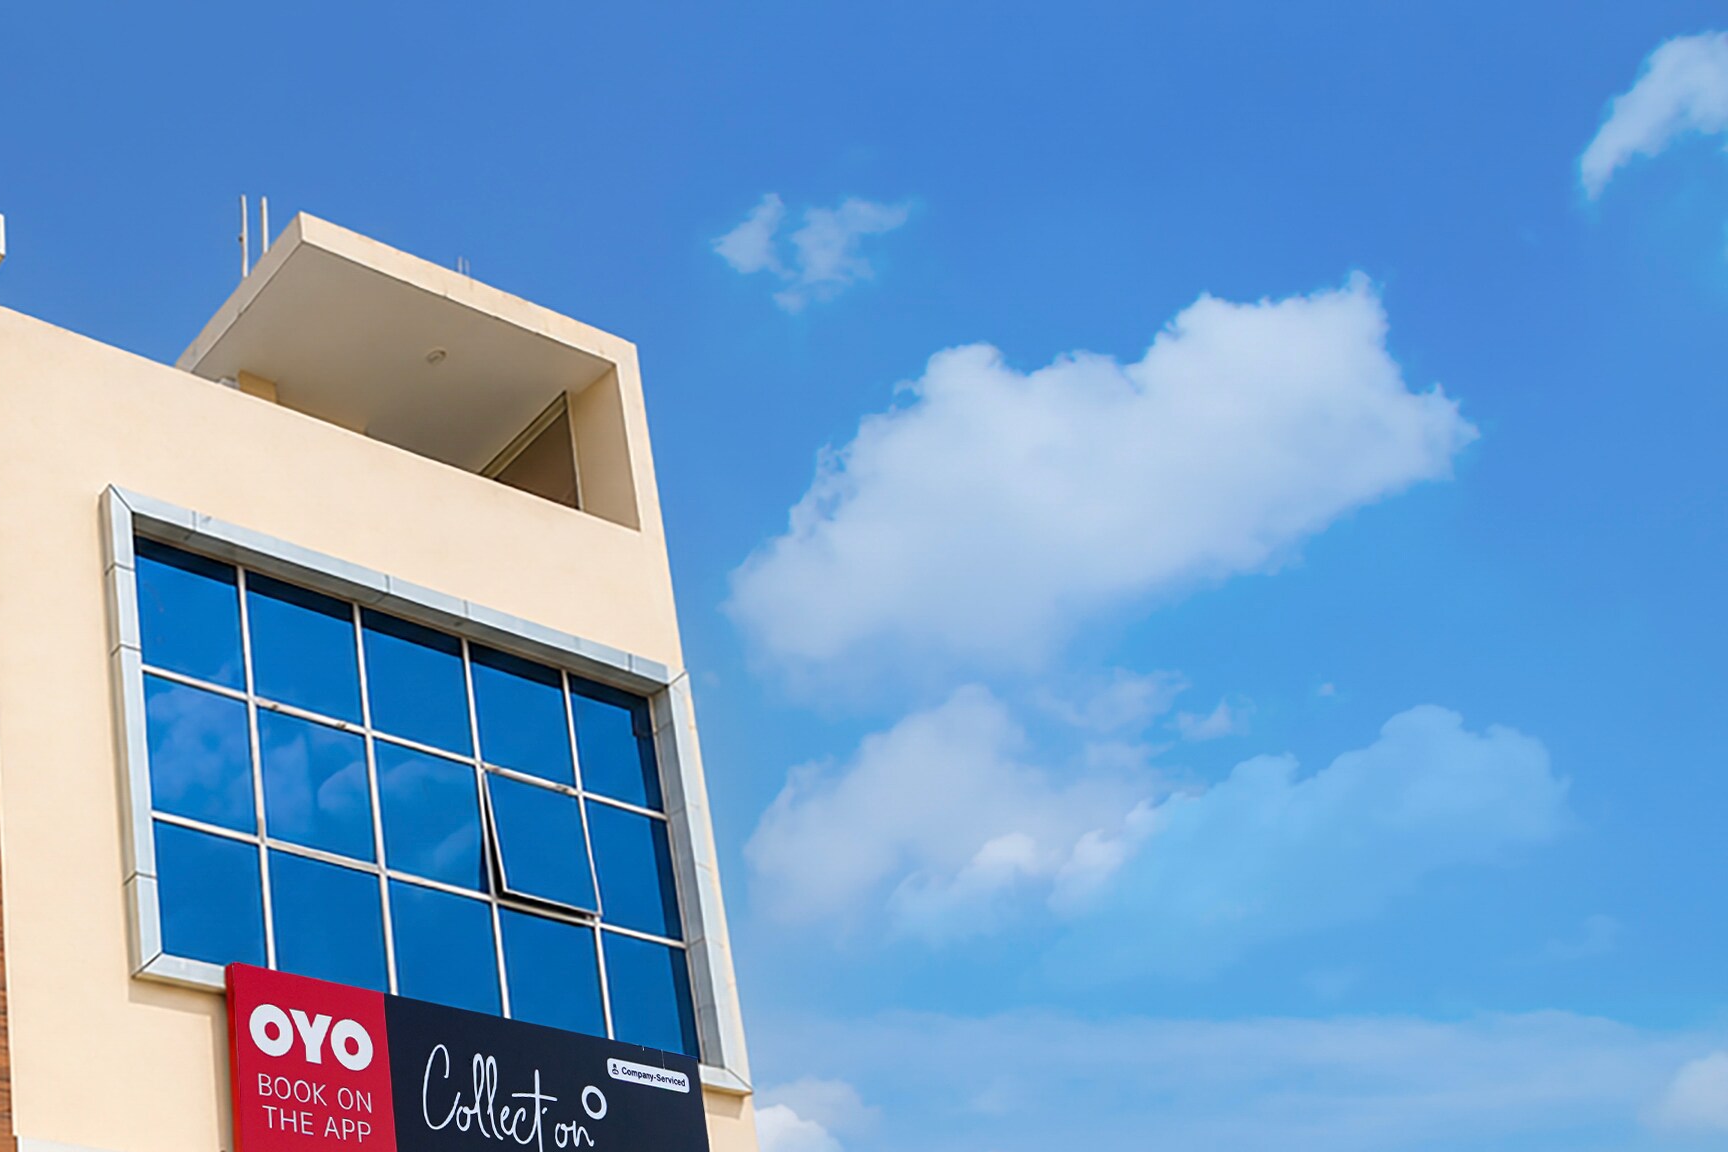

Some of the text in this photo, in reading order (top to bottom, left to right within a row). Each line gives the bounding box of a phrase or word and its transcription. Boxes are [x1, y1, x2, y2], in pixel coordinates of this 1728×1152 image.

[249, 1004, 374, 1071] OYO
[258, 1073, 372, 1113] BOOK ON
[621, 1066, 687, 1087] Company-Serviced
[262, 1105, 371, 1143] THE APP
